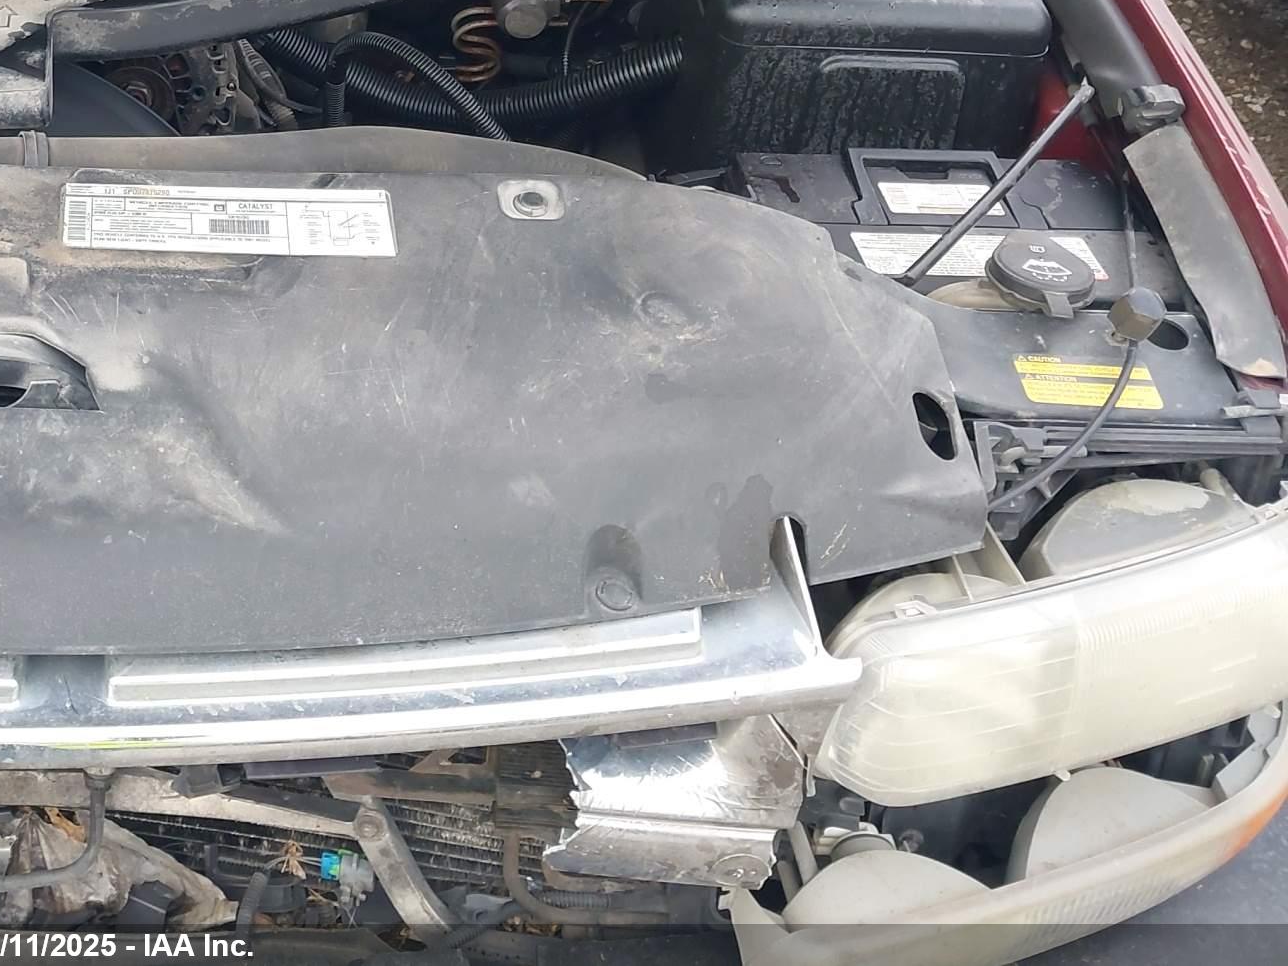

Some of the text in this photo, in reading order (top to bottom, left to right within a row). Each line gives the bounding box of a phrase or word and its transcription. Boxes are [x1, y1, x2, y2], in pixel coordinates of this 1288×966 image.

[238, 202, 273, 210] CATALYST
[1027, 355, 1062, 364] CAUTION
[1035, 374, 1078, 383] ATTENTION
